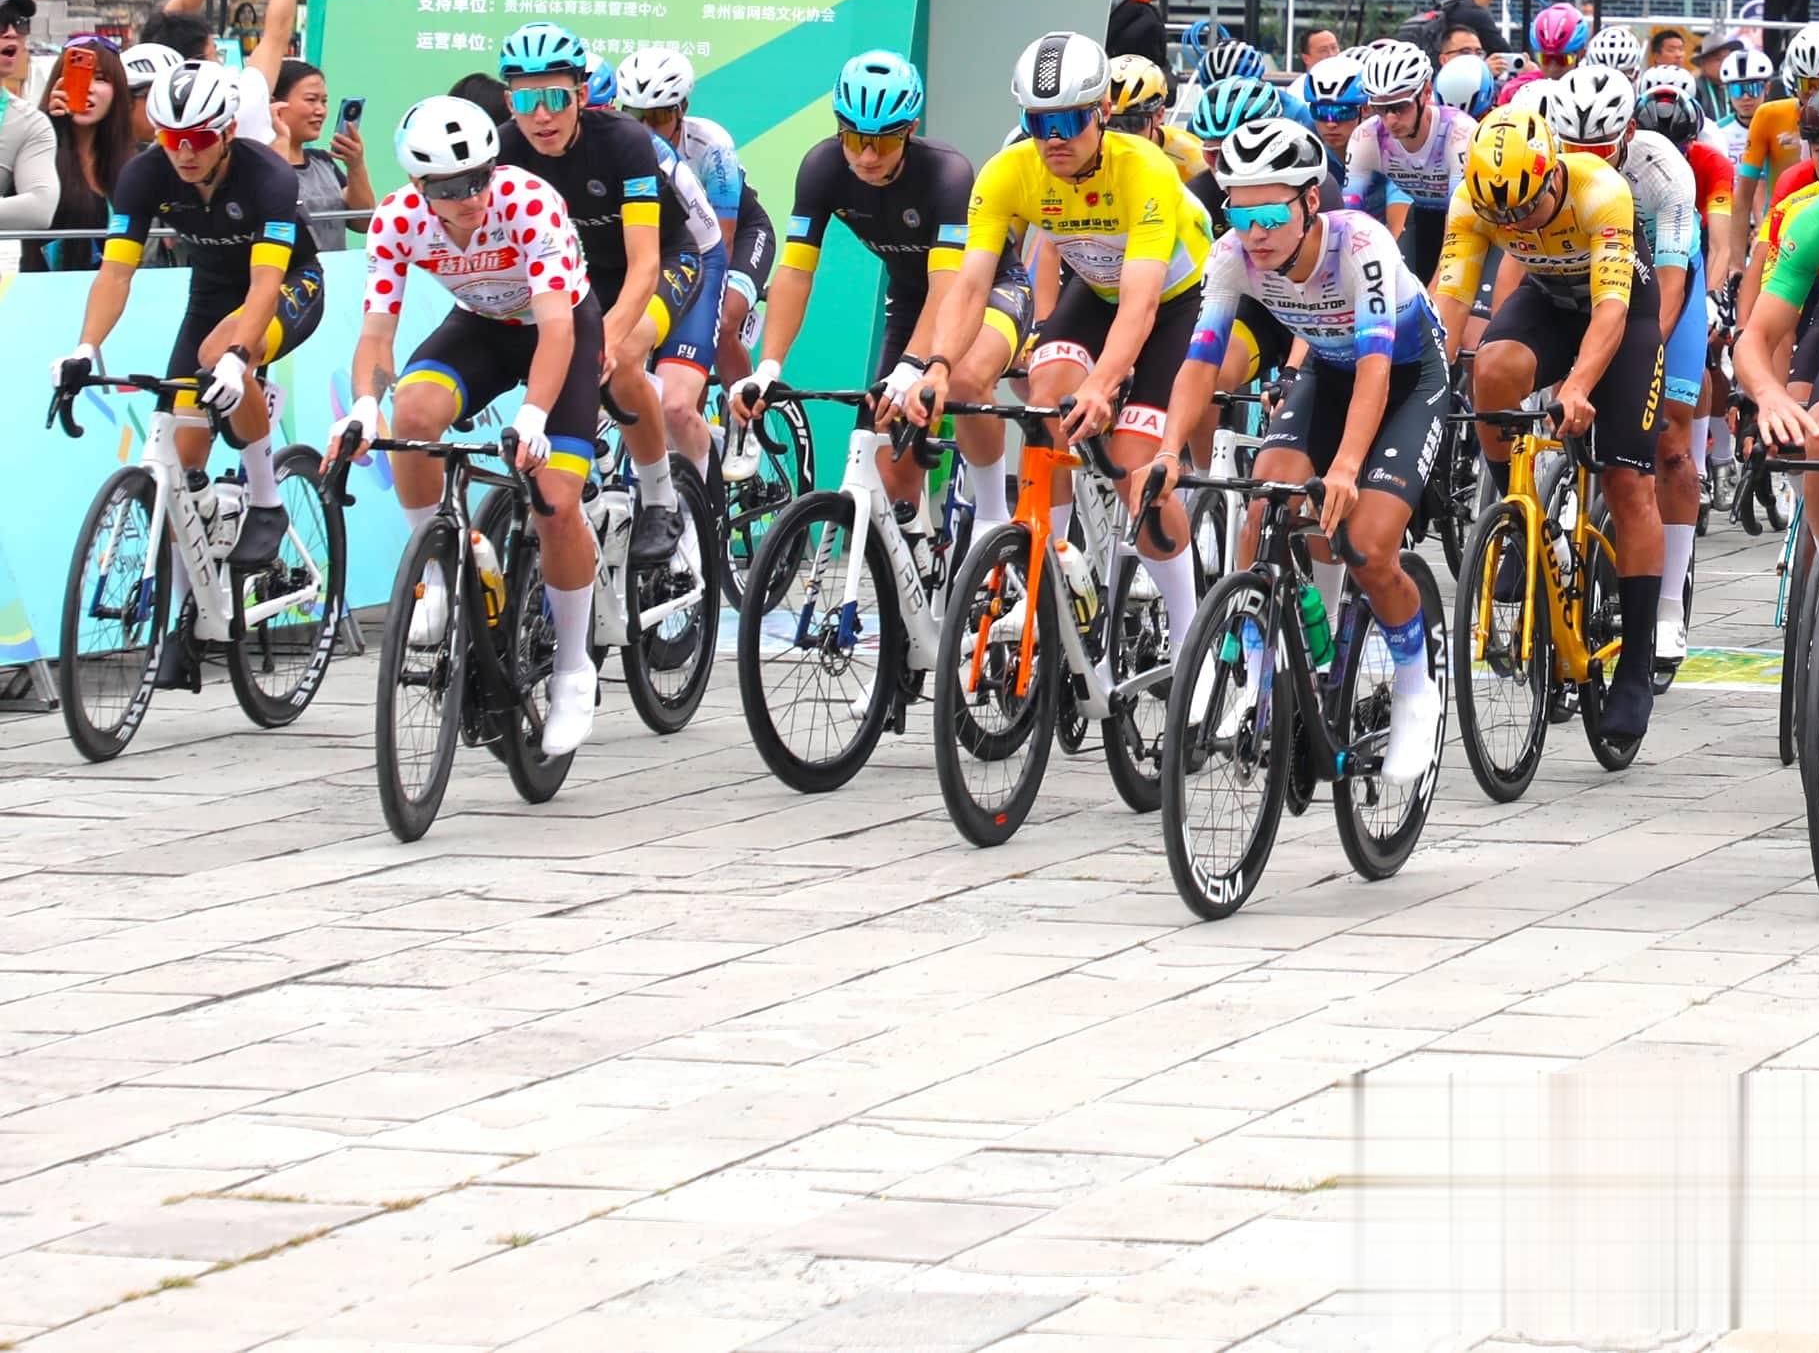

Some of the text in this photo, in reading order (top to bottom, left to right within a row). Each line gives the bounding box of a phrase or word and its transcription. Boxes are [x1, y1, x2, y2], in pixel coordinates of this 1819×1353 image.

[702, 3, 837, 24] 贵州省网络文化协会
[1362, 261, 1386, 315] DYC
[1641, 344, 1666, 432] GUSTO
